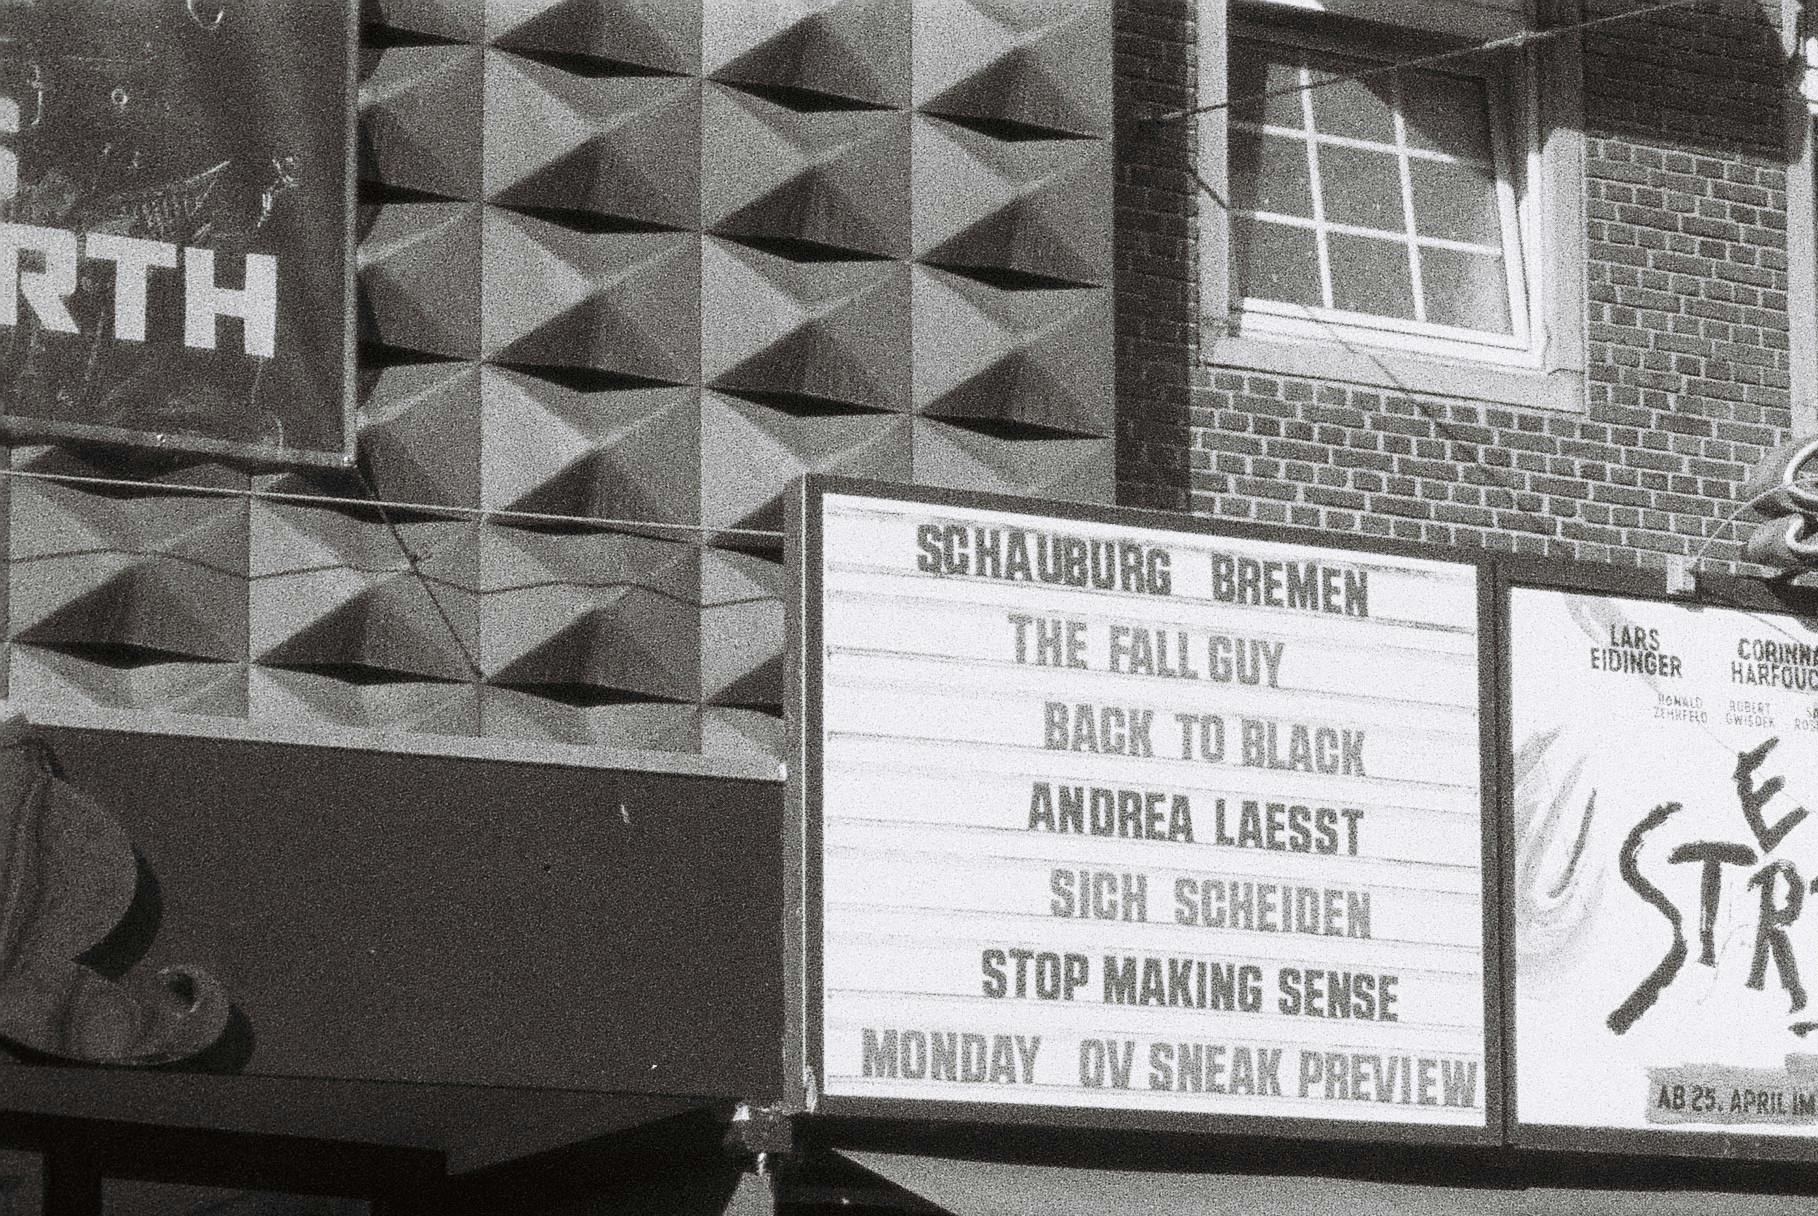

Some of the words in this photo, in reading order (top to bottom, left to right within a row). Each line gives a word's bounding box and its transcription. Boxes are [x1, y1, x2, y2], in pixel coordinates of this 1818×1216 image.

[918, 523, 1171, 596] SCHAUBURG
[1212, 555, 1369, 618] BREMEN
[1008, 613, 1088, 671] THE
[1109, 625, 1199, 681] FALL
[1208, 635, 1285, 689] GUY
[1591, 648, 1683, 678] EIDINGER
[1610, 624, 1660, 651] LARS
[1044, 702, 1154, 758] BACK
[1174, 713, 1225, 764] TO
[1241, 719, 1368, 778] BLACK
[1028, 783, 1194, 844] ANDREA
[1215, 798, 1364, 857] LAESST
[1051, 868, 1149, 923] SICH
[1175, 878, 1372, 940] SCHEIDEN
[982, 948, 1090, 1001] STOP
[1103, 955, 1262, 1013] MAKING
[1278, 967, 1399, 1023] SENSE
[862, 1028, 1042, 1084] MONDAY
[1080, 1039, 1135, 1091] OV
[1149, 1042, 1282, 1098] SNEAK
[1298, 1050, 1479, 1109] PREVIEW
[1657, 1084, 1686, 1111] AB
[1692, 1084, 1723, 1113] 25.
[1729, 1088, 1787, 1116] APRIL
